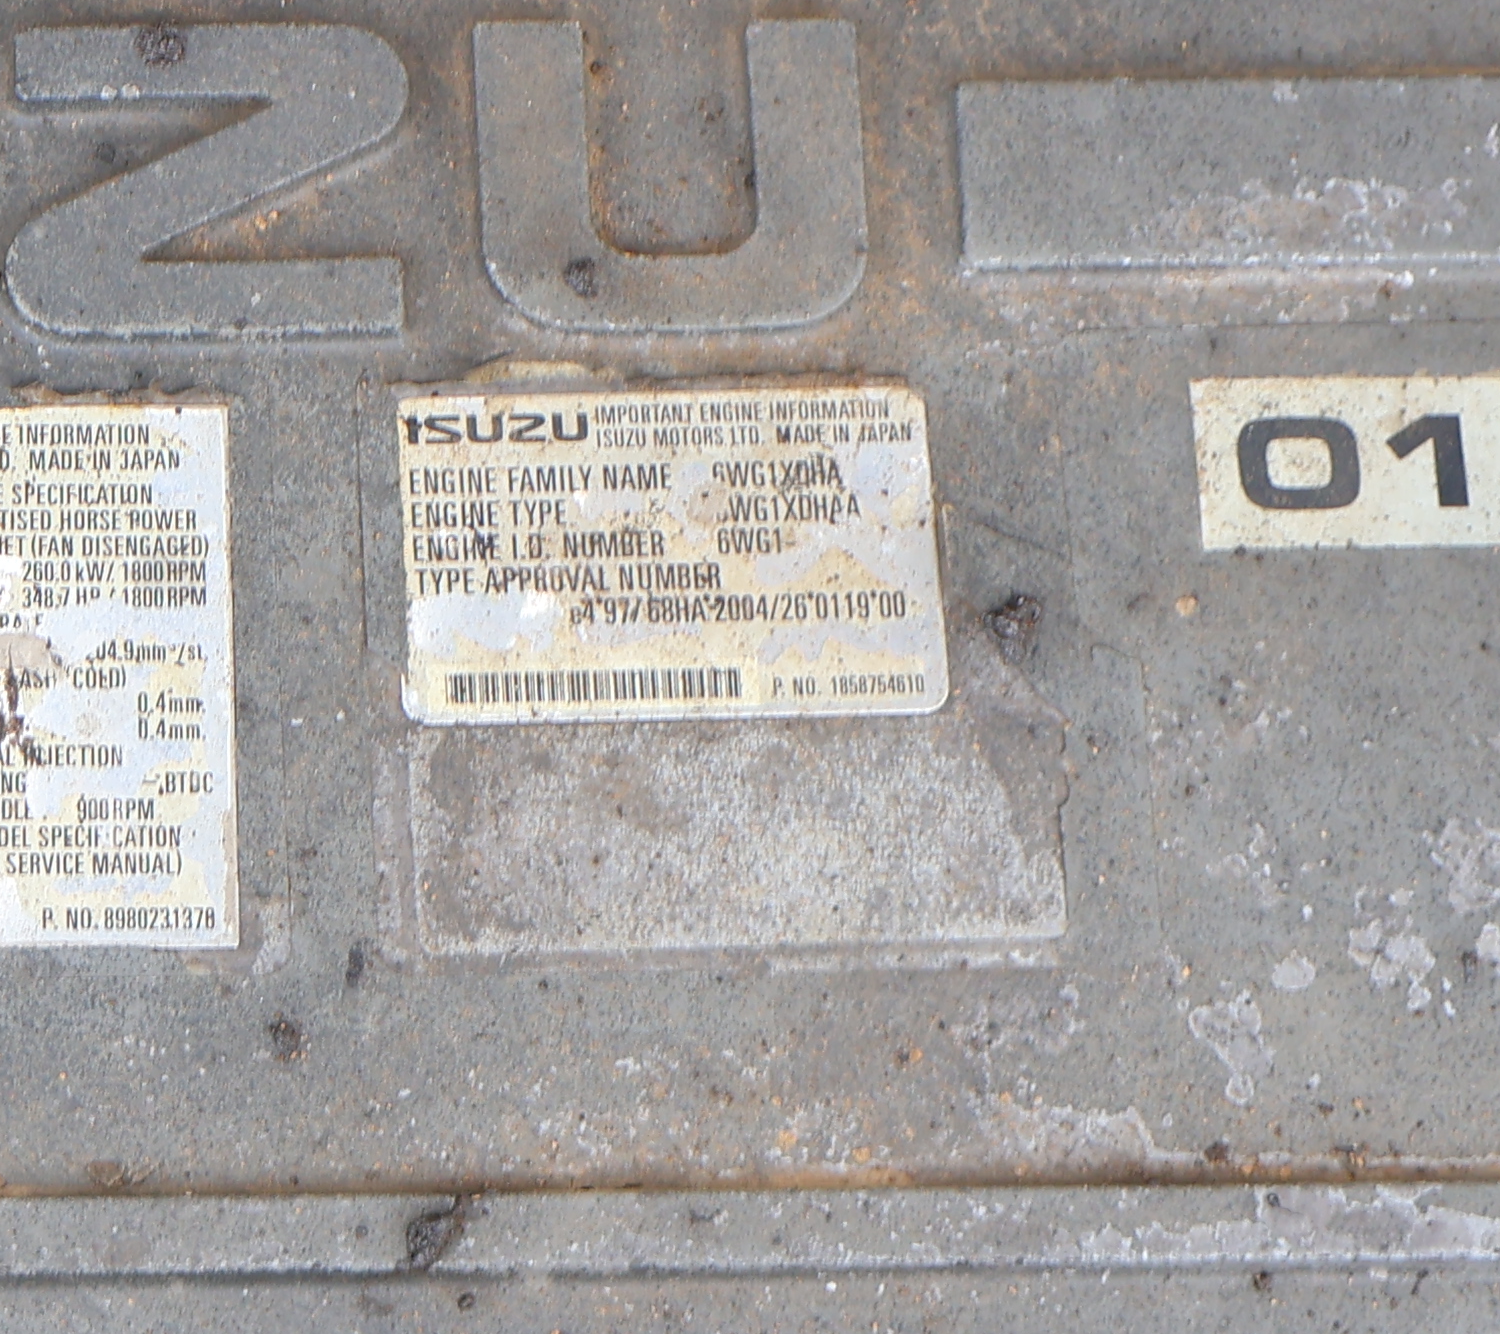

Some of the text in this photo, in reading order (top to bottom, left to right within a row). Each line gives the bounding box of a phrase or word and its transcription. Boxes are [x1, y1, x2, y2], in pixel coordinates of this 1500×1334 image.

[595, 398, 890, 427] IMPORTANT ENGINE INFORMATION
[17, 423, 150, 445] INFORMATION
[405, 412, 590, 445] ISUZU
[596, 425, 647, 448] ISUZU
[653, 424, 723, 447] MOTORS
[776, 423, 827, 445] MADE
[834, 422, 850, 443] IN
[857, 421, 912, 444] JAPAN
[29, 449, 84, 471] MADE
[93, 449, 111, 471] IN
[120, 449, 180, 471] JAPAN
[1237, 413, 1469, 510] 01
[409, 466, 498, 496] ENGINE
[507, 464, 592, 494] FAMILY
[603, 462, 673, 491] NAME
[12, 482, 153, 505] SPECIFICATION
[60, 508, 121, 531] HORSE
[130, 508, 197, 531] POWER
[411, 493, 862, 529] ENGINE TYPE WG1XDHAA
[31, 534, 74, 557] (FAN
[82, 534, 209, 557] DISENGAGED)
[413, 532, 502, 562] ENGINE
[563, 529, 665, 559] NUMBER
[414, 561, 722, 595] TYPE APPROVAL NUMBER
[794, 675, 821, 696] NO.
[112, 797, 155, 820] RPM
[39, 825, 182, 848] SPECIFCATION
[6, 852, 84, 875] SERVICE
[93, 852, 183, 875] MANUAL)
